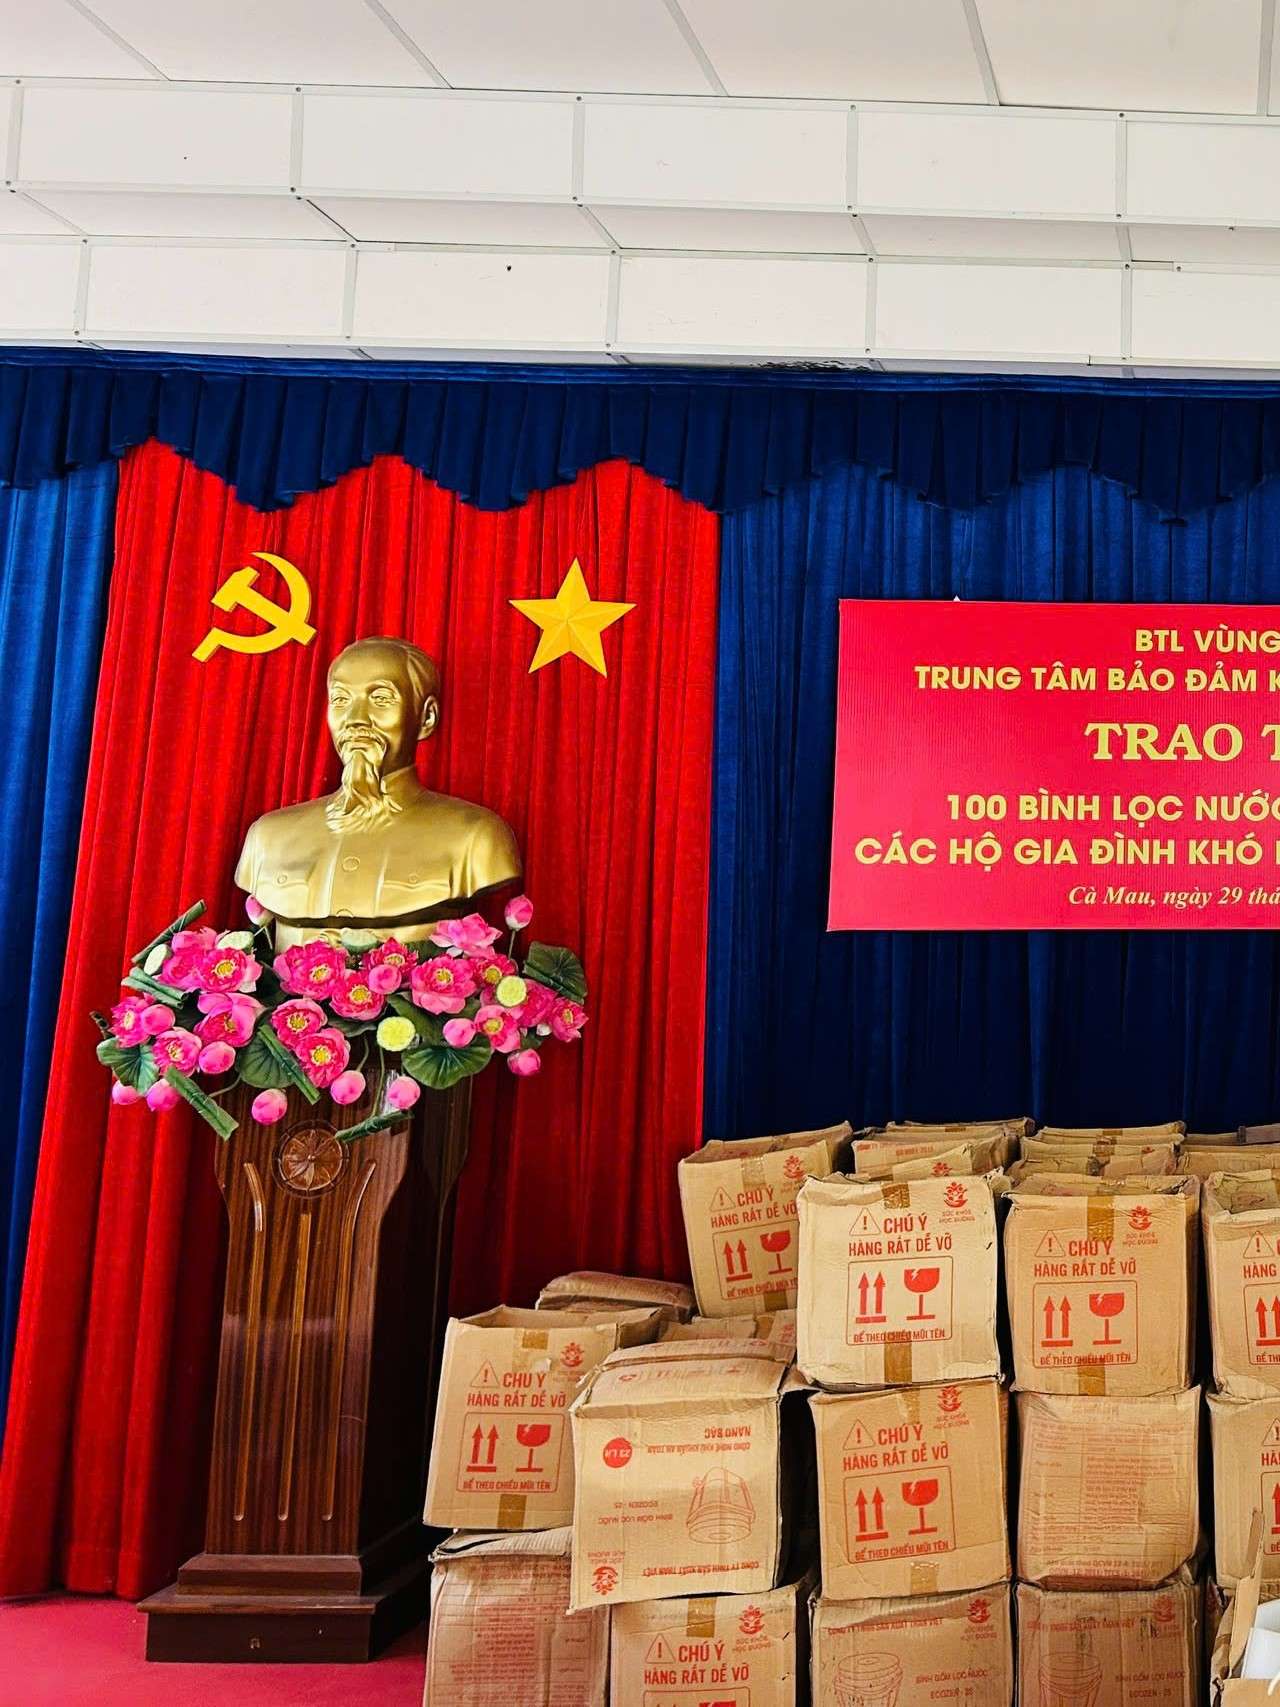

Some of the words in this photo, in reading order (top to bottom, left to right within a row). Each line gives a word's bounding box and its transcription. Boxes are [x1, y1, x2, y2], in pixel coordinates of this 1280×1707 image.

[1135, 629, 1184, 652] BTL
[914, 665, 1022, 690] TRUNG
[1031, 660, 1097, 690] TÂM
[1107, 660, 1175, 692] BẢO
[1185, 660, 1257, 692] ĐẢM
[1084, 722, 1244, 762] TRAO
[947, 795, 1007, 821] 100
[1019, 788, 1099, 821] BÌNH
[1113, 795, 1184, 828] LỌC
[855, 830, 937, 865] CÁC
[949, 831, 1002, 872] HỘ
[1014, 837, 1078, 865] GIA
[1089, 831, 1175, 865] ĐÌNH
[1188, 832, 1263, 866] KHÓ
[1068, 886, 1097, 905] Cà
[1103, 886, 1156, 907] Mau,
[1163, 887, 1212, 909] ngày
[1217, 886, 1243, 905] 29
[884, 1214, 914, 1234] CHÚ
[919, 1212, 928, 1231] Ý
[849, 1239, 883, 1256] HÀNG
[1068, 1239, 1098, 1256] CHÚ
[1034, 1260, 1067, 1277] HÀNG
[1243, 1262, 1277, 1279] HÀNG
[467, 1391, 499, 1407] HÀNG
[878, 1423, 909, 1446] CHÚ
[843, 1453, 878, 1471] HÀNG
[678, 1641, 709, 1663] CHÚ
[714, 1640, 725, 1661] Ý
[644, 1668, 677, 1685] HÀNG
